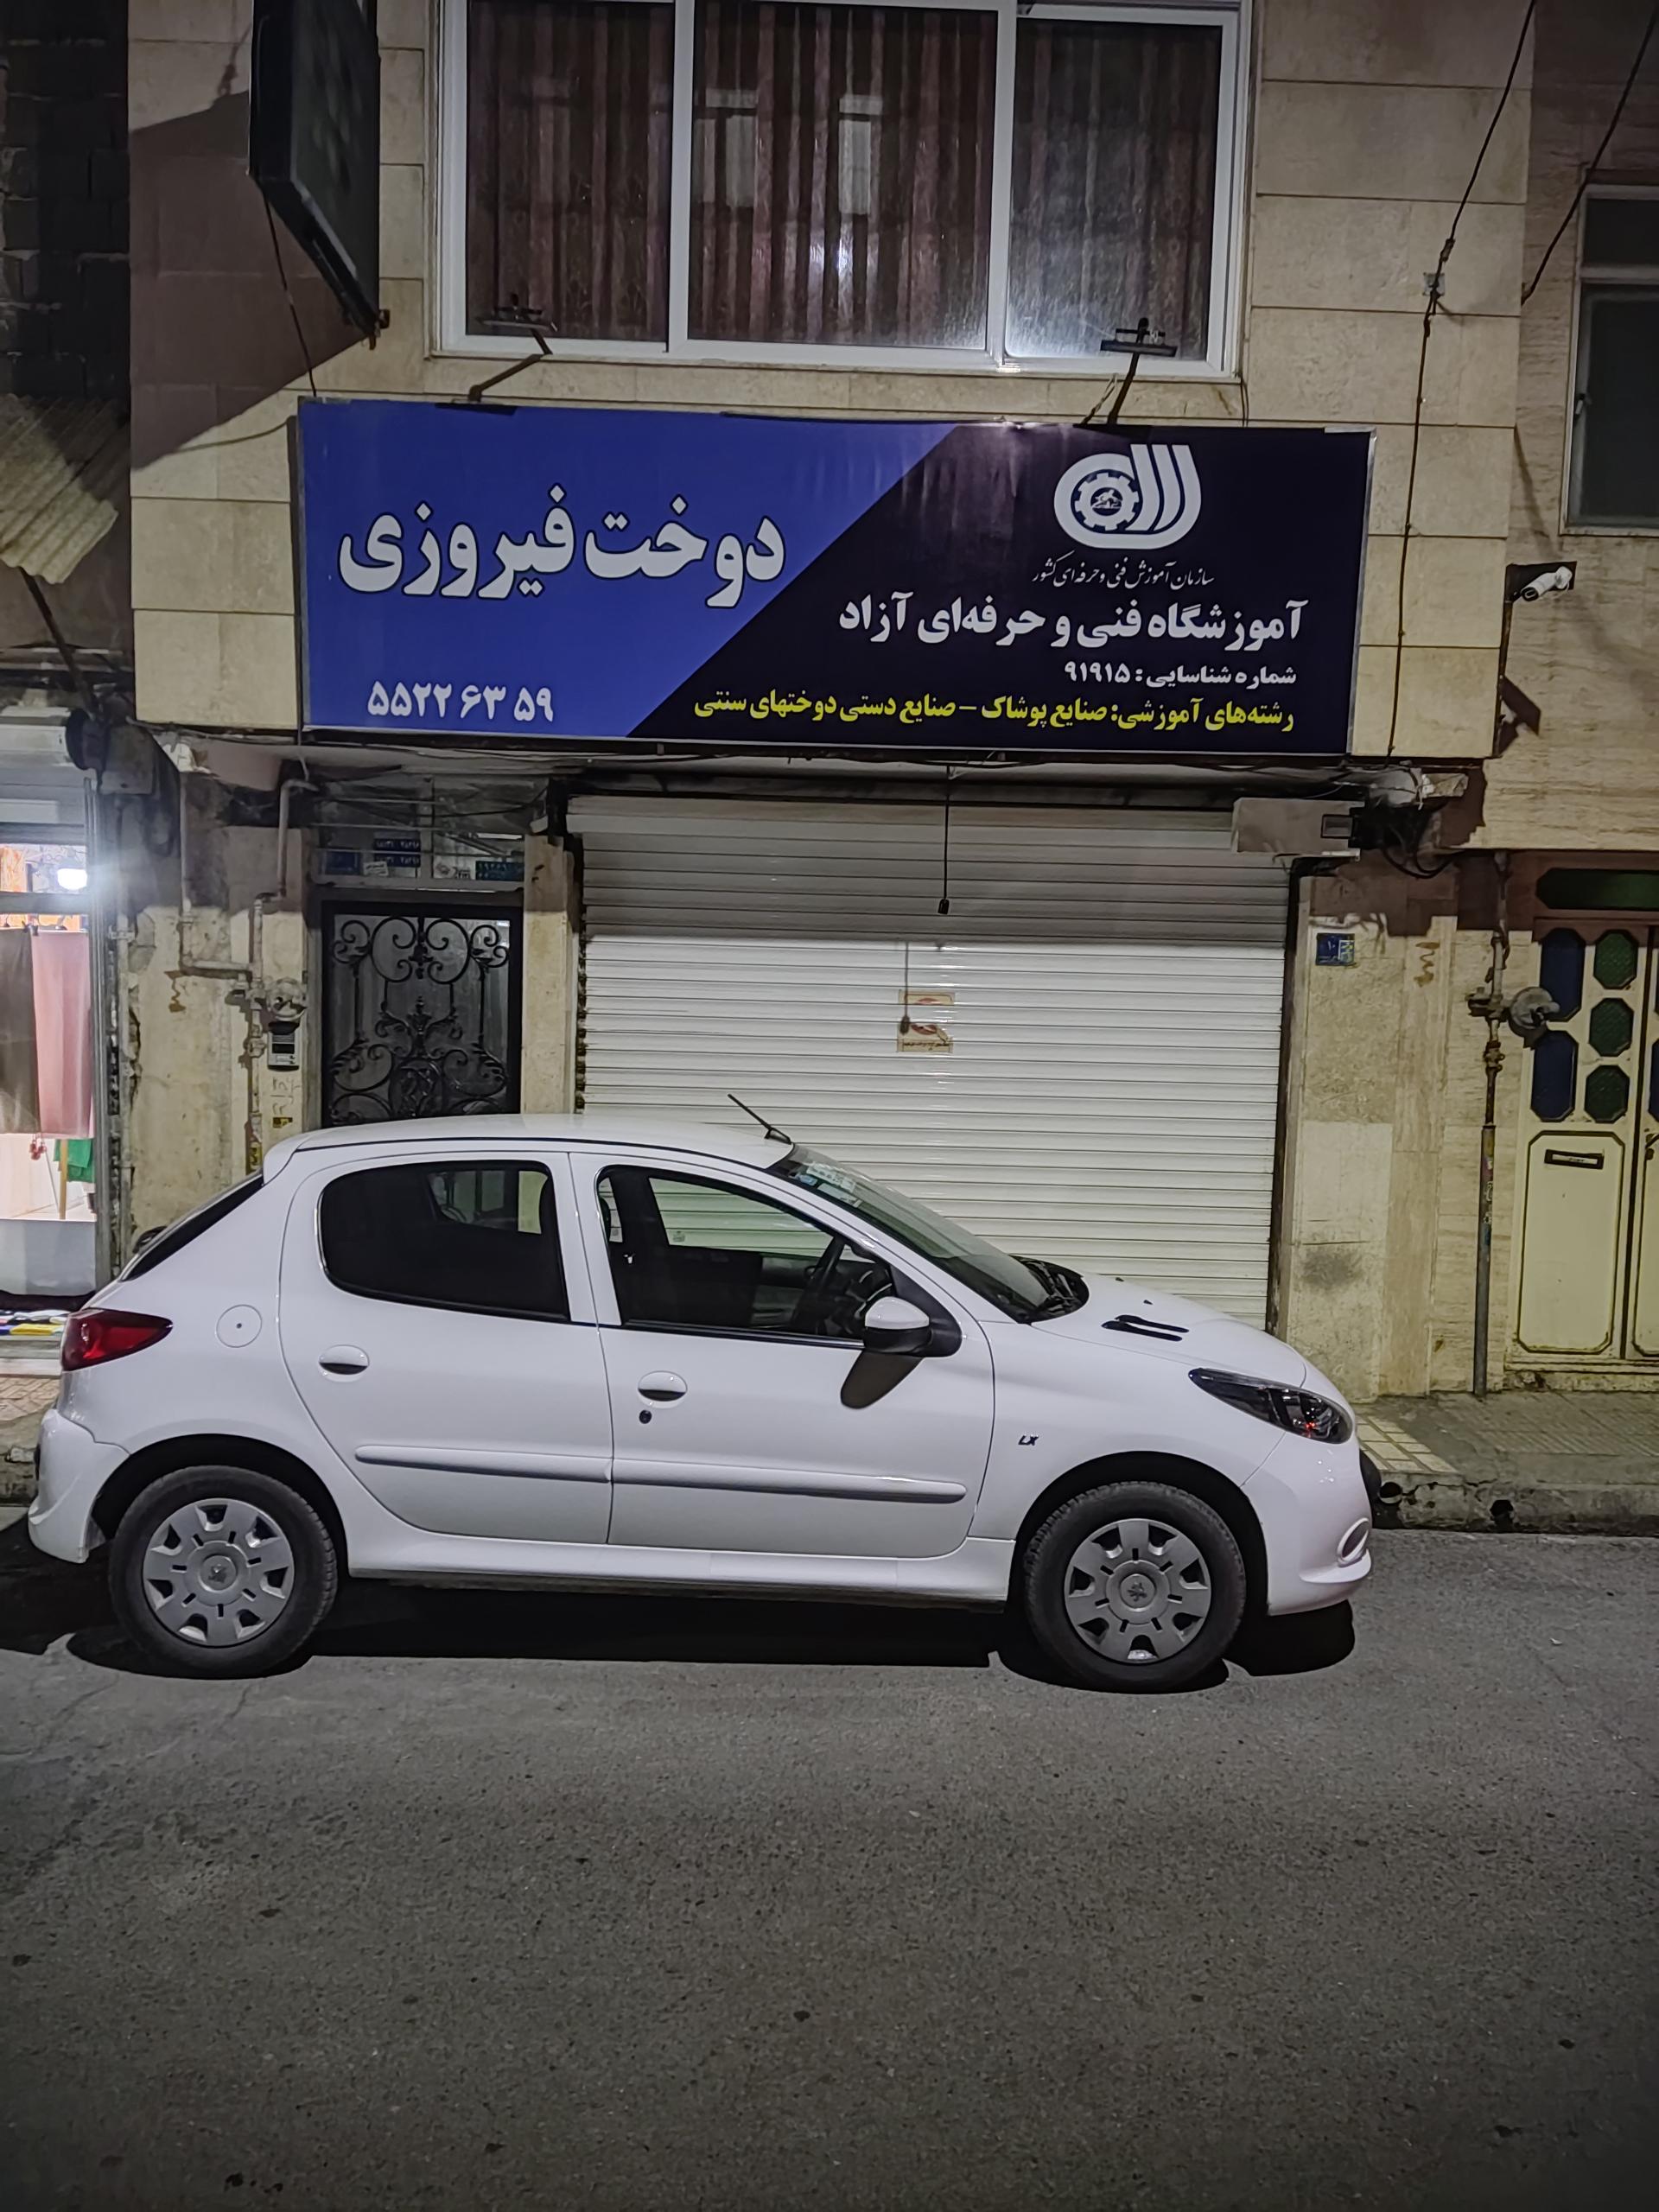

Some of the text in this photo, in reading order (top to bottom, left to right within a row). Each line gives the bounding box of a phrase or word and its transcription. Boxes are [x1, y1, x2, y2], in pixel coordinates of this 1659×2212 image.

[339, 484, 785, 607] دوخت فیروزی
[1032, 550, 1075, 582] کشور
[1107, 557, 1128, 588] فنی
[1124, 560, 1177, 588] آموزش
[1170, 568, 1214, 590] سازمان
[839, 591, 913, 642] آزاد
[1051, 615, 1071, 647] و
[1077, 599, 1141, 647] فنی
[1147, 600, 1309, 651] آموزشگاه
[1065, 661, 1130, 683] ۹۱۹۱۵
[1235, 666, 1297, 689] شماره
[694, 690, 747, 717] سنتی
[839, 696, 897, 721] دستی
[899, 693, 957, 723] صنایع
[981, 696, 1046, 728] پوشاک
[1050, 696, 1108, 728] صنایع
[1018, 1434, 1039, 1446] LX
